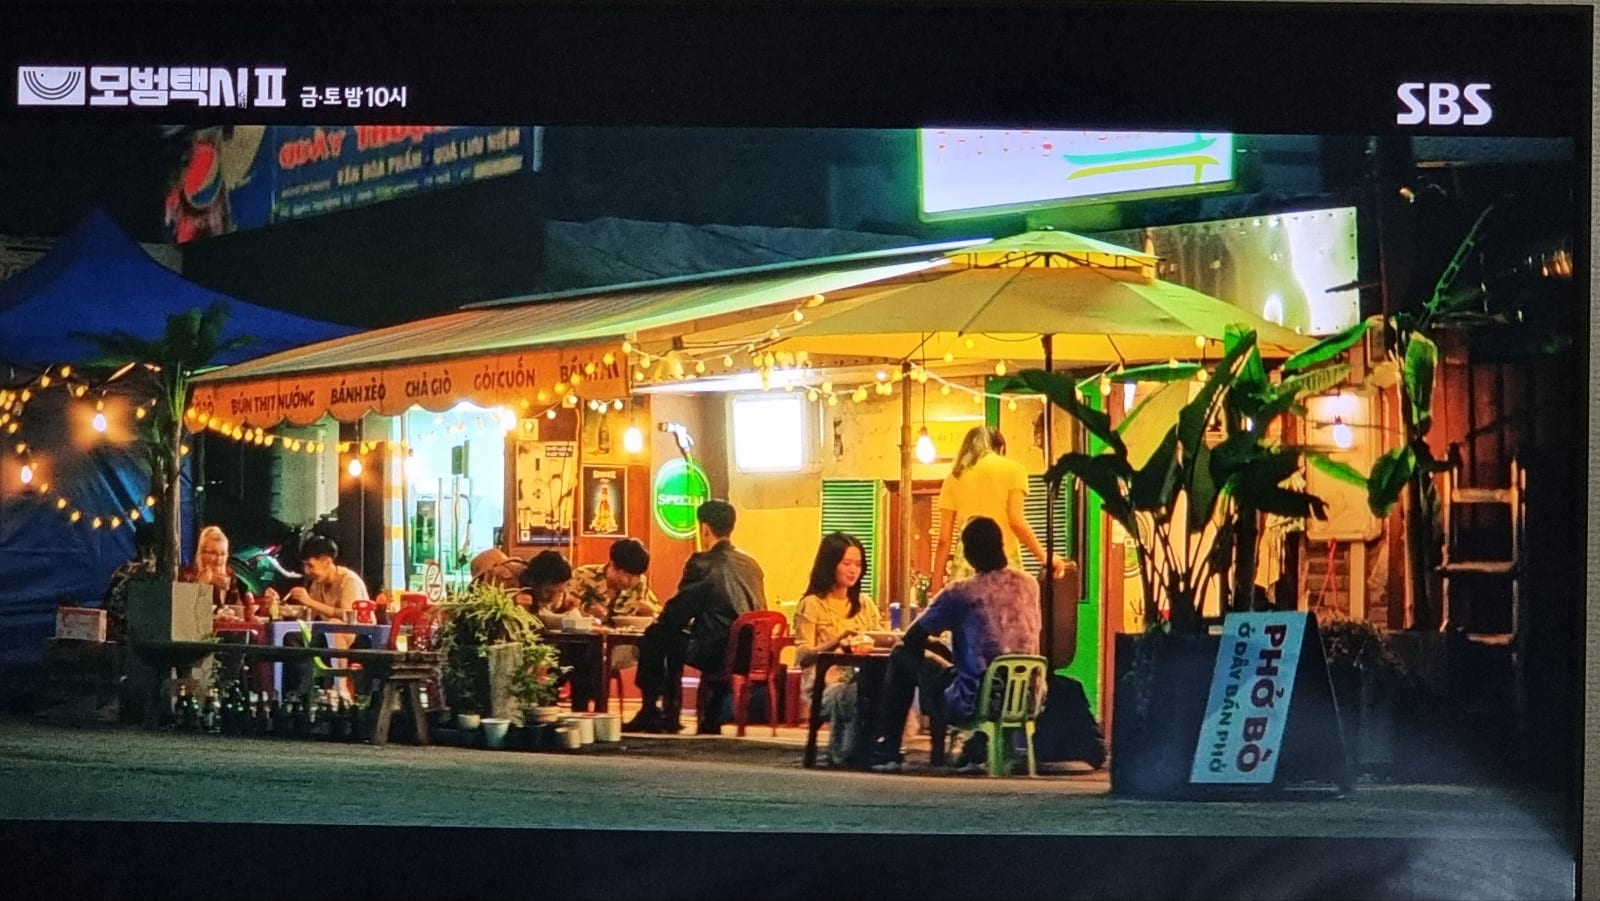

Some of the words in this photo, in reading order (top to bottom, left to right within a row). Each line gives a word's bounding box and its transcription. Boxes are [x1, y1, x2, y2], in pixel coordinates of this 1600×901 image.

[90, 66, 249, 109] 모범택시
[1397, 82, 1493, 126] SBS
[331, 379, 362, 405] BÁNH
[405, 371, 428, 398] CHẢ
[431, 369, 452, 395] GIÒ
[497, 355, 535, 388] CUỐN
[1251, 624, 1288, 709] PHỞ
[1219, 684, 1240, 726] BÁN
[1236, 716, 1273, 773] BÒ
